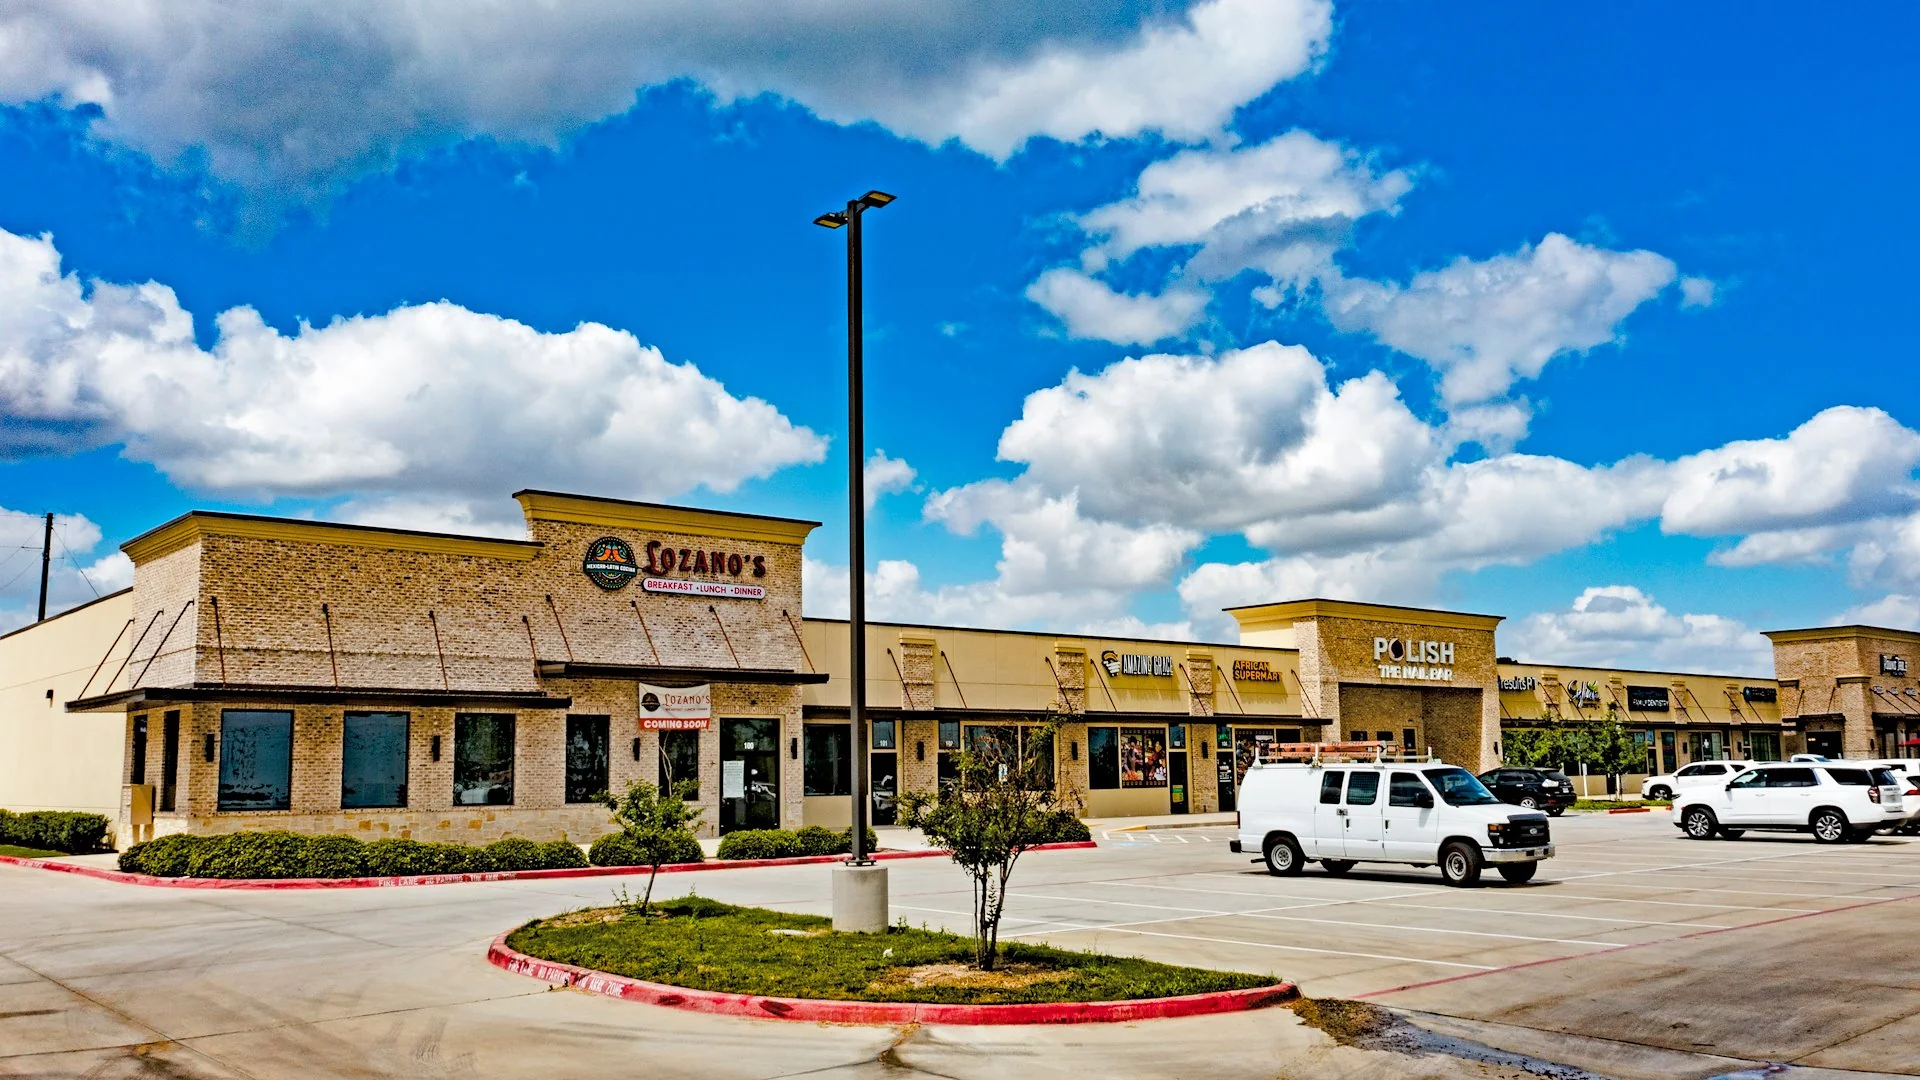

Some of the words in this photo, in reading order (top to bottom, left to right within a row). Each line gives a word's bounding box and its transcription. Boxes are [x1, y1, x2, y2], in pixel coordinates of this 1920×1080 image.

[642, 540, 766, 578] LOZANO'S
[647, 580, 694, 591] BREAKFAST
[700, 584, 727, 594] LUNCH
[734, 586, 762, 597] DINNER
[1373, 637, 1455, 664] POLISH
[1122, 655, 1151, 675] AMAZING
[1153, 656, 1174, 676] GRACE
[1234, 660, 1271, 671] AFRICAN
[1234, 670, 1283, 681] SUPERMART
[1378, 665, 1402, 678] THE
[1402, 666, 1429, 680] NAIL
[1429, 668, 1453, 681] BAR
[662, 693, 710, 707] LOZANO'S
[643, 720, 683, 729] COMING
[683, 720, 707, 729] SOON
[744, 742, 754, 750] 100
[379, 879, 396, 887] FIRE
[399, 878, 418, 887] LANE
